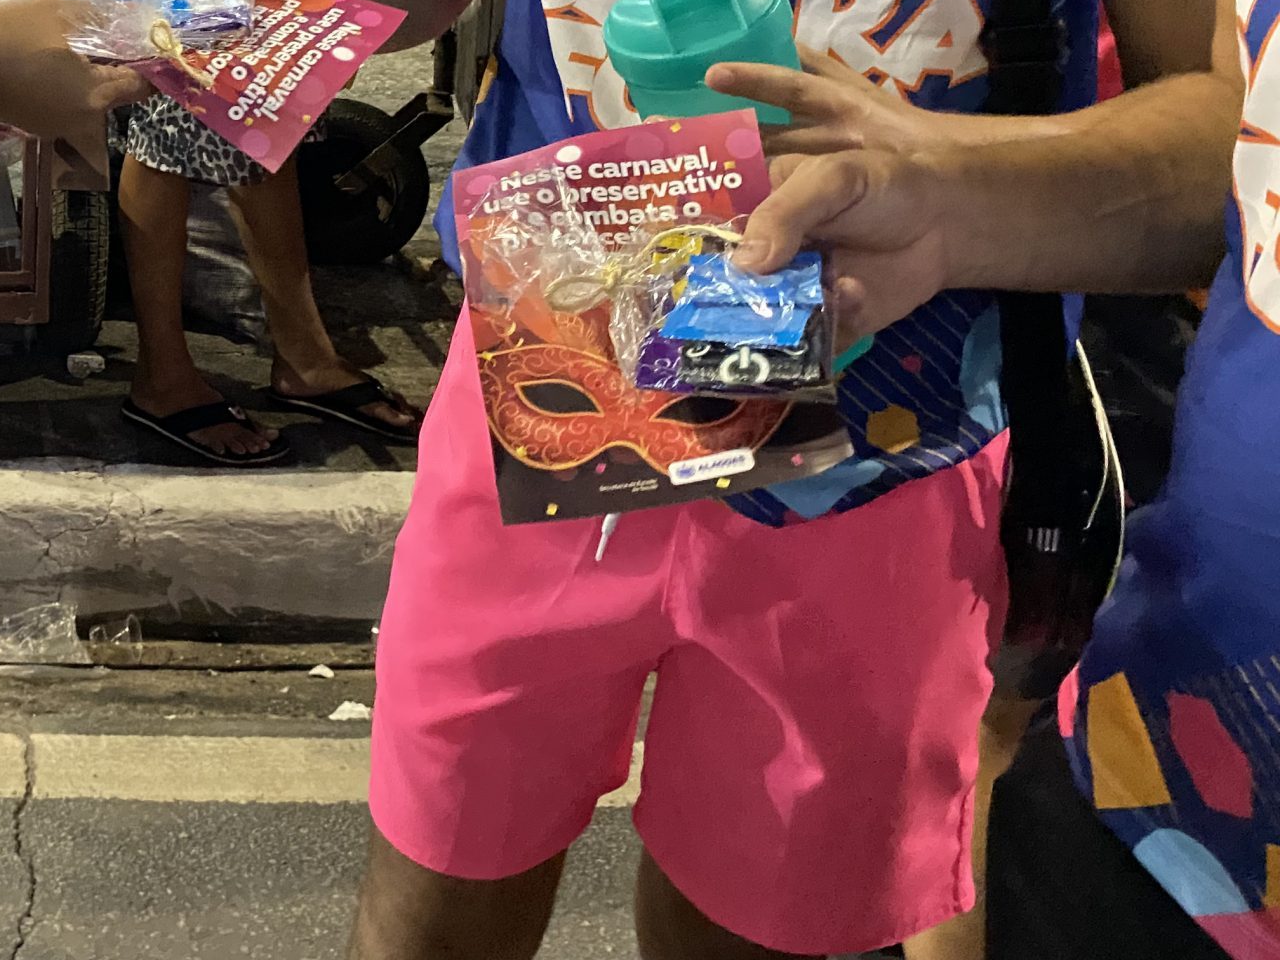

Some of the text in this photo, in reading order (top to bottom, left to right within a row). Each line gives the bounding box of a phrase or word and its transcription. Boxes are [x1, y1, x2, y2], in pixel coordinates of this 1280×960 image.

[308, 25, 324, 34] o
[316, 7, 345, 29] use
[316, 21, 362, 51] Nesse
[231, 15, 309, 81] e combata o
[228, 30, 316, 121] preservativo
[253, 49, 323, 122] carnaval,
[500, 146, 718, 192] Nesse carnaval,
[483, 170, 742, 214] use o preservativo
[550, 201, 678, 227] combata
[682, 201, 702, 218] o
